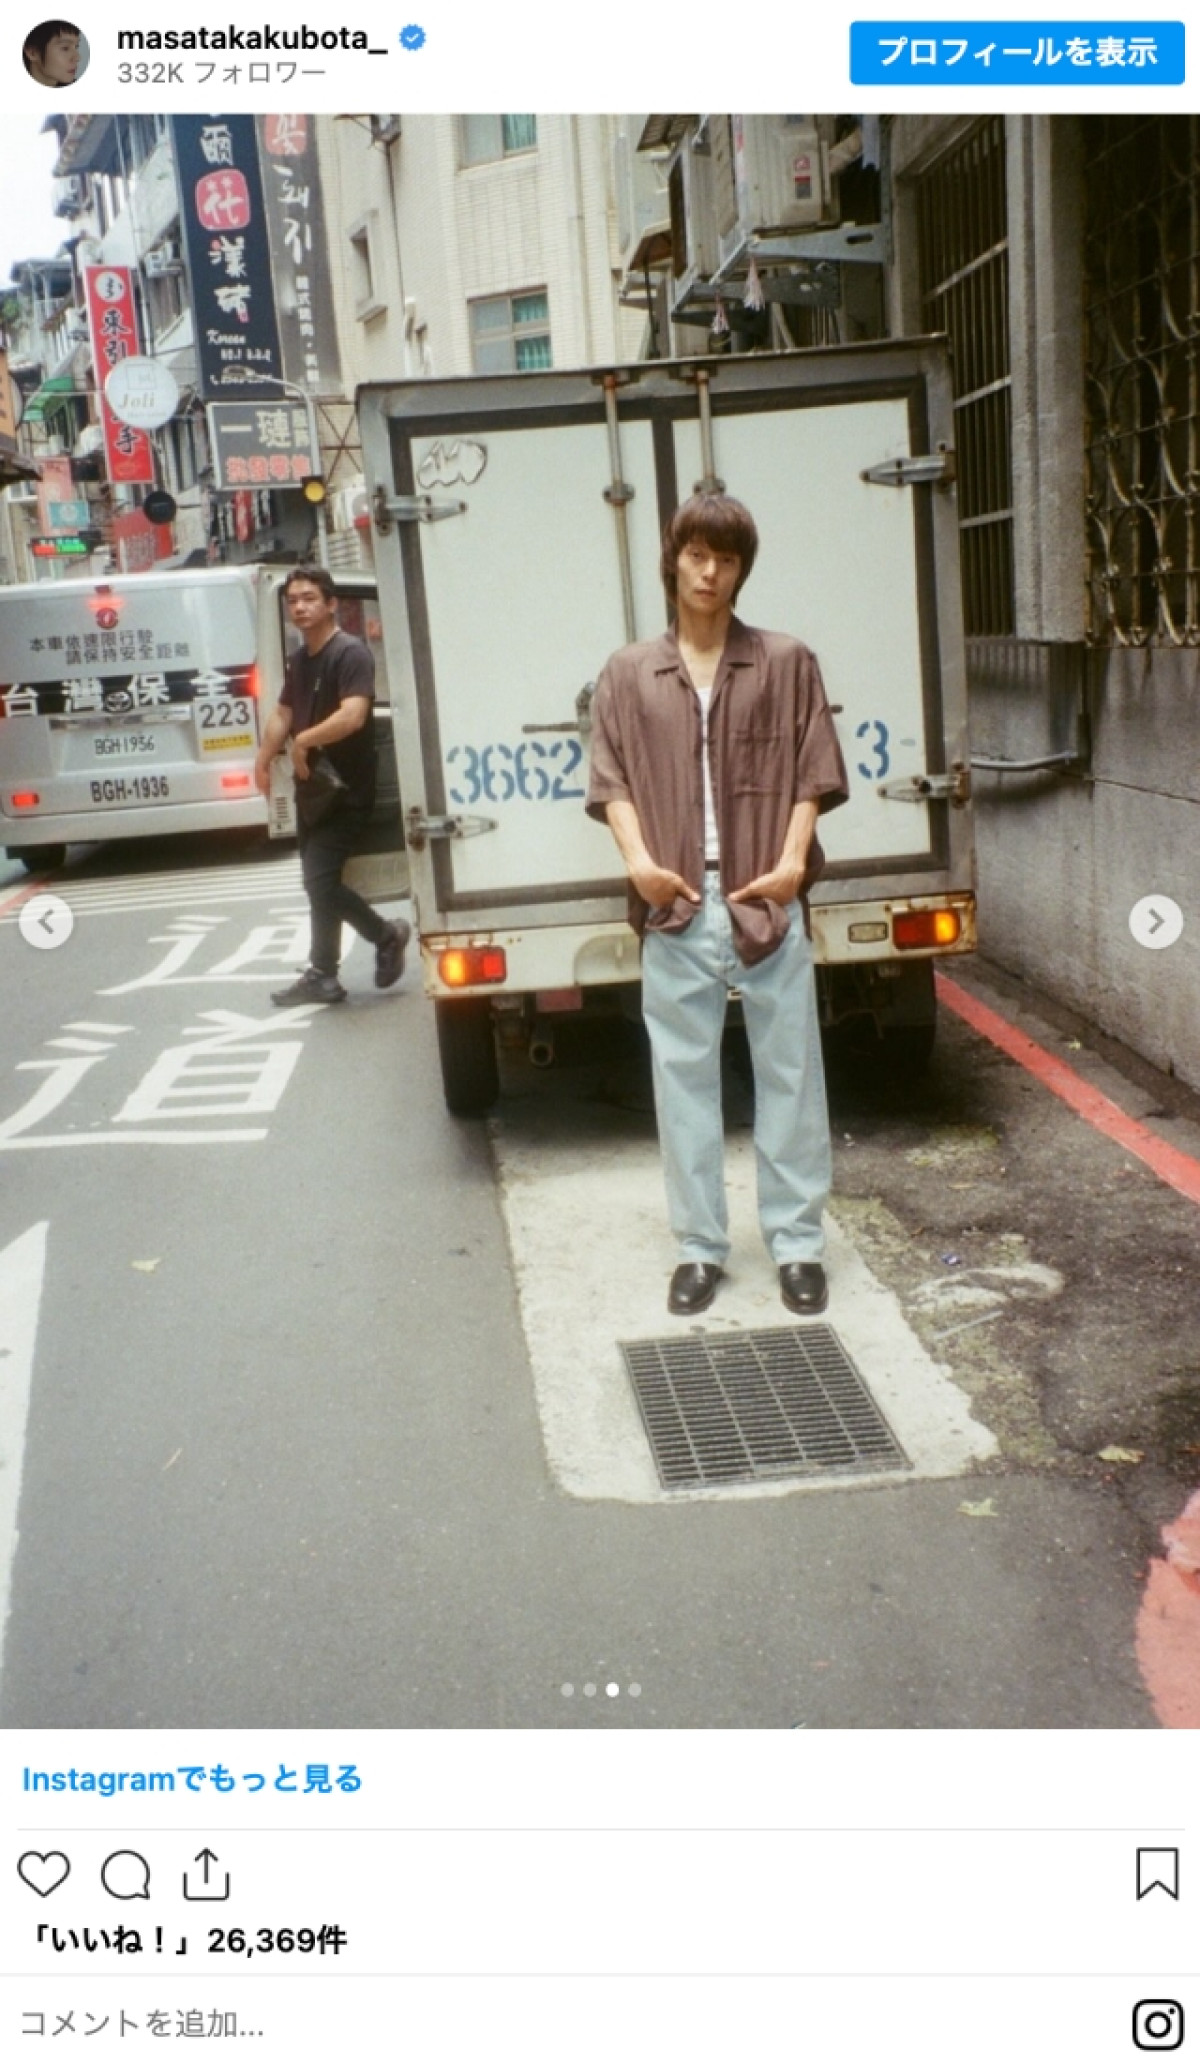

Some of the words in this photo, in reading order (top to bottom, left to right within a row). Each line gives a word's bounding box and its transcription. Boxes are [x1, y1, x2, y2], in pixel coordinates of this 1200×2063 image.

[118, 392, 156, 409] Joli
[1, 668, 232, 719] 台灣保全
[199, 701, 250, 728] 223
[446, 739, 586, 804] 3662
[89, 775, 170, 803] BGH-1936
